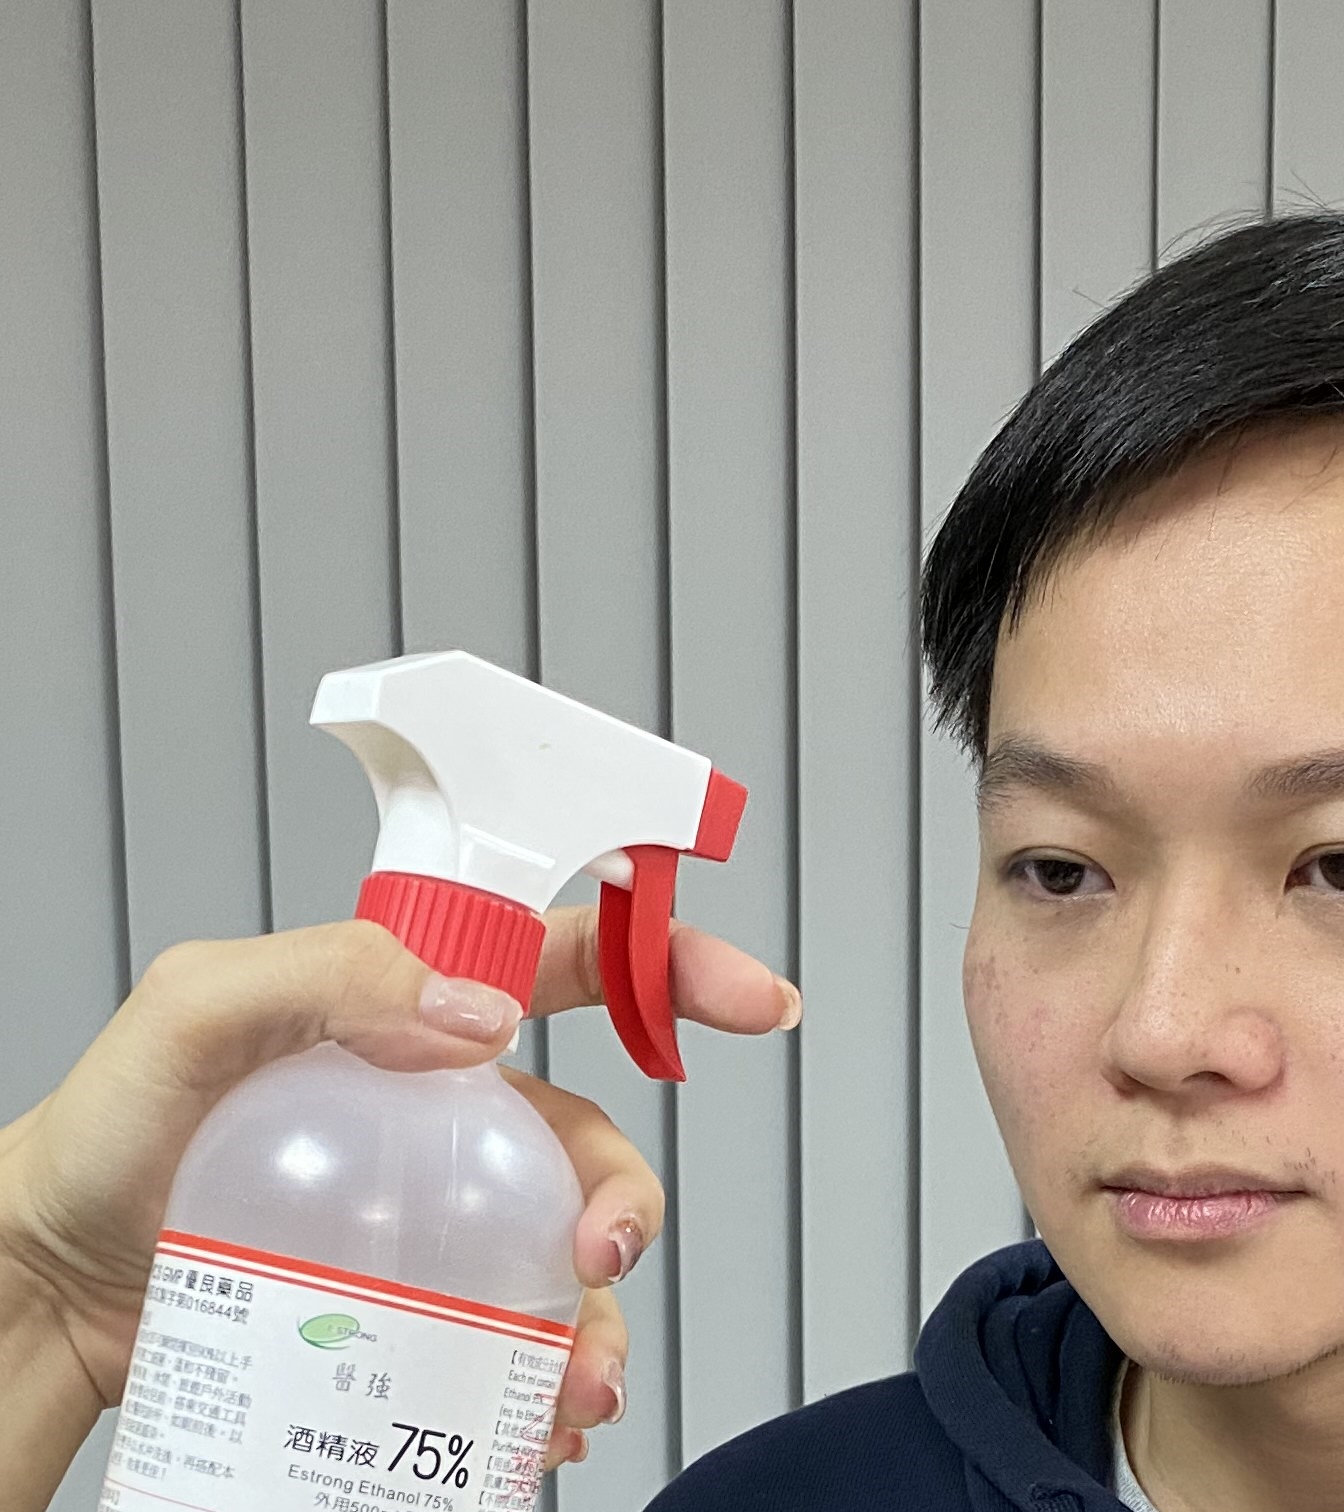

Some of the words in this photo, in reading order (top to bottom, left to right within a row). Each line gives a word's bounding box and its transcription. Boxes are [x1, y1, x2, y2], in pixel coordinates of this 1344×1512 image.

[282, 1424, 380, 1468] 酒精液
[387, 1421, 475, 1489] 75%
[288, 1464, 354, 1493] Estrong
[358, 1480, 421, 1506] Ethanol
[424, 1493, 454, 1512] 75%
